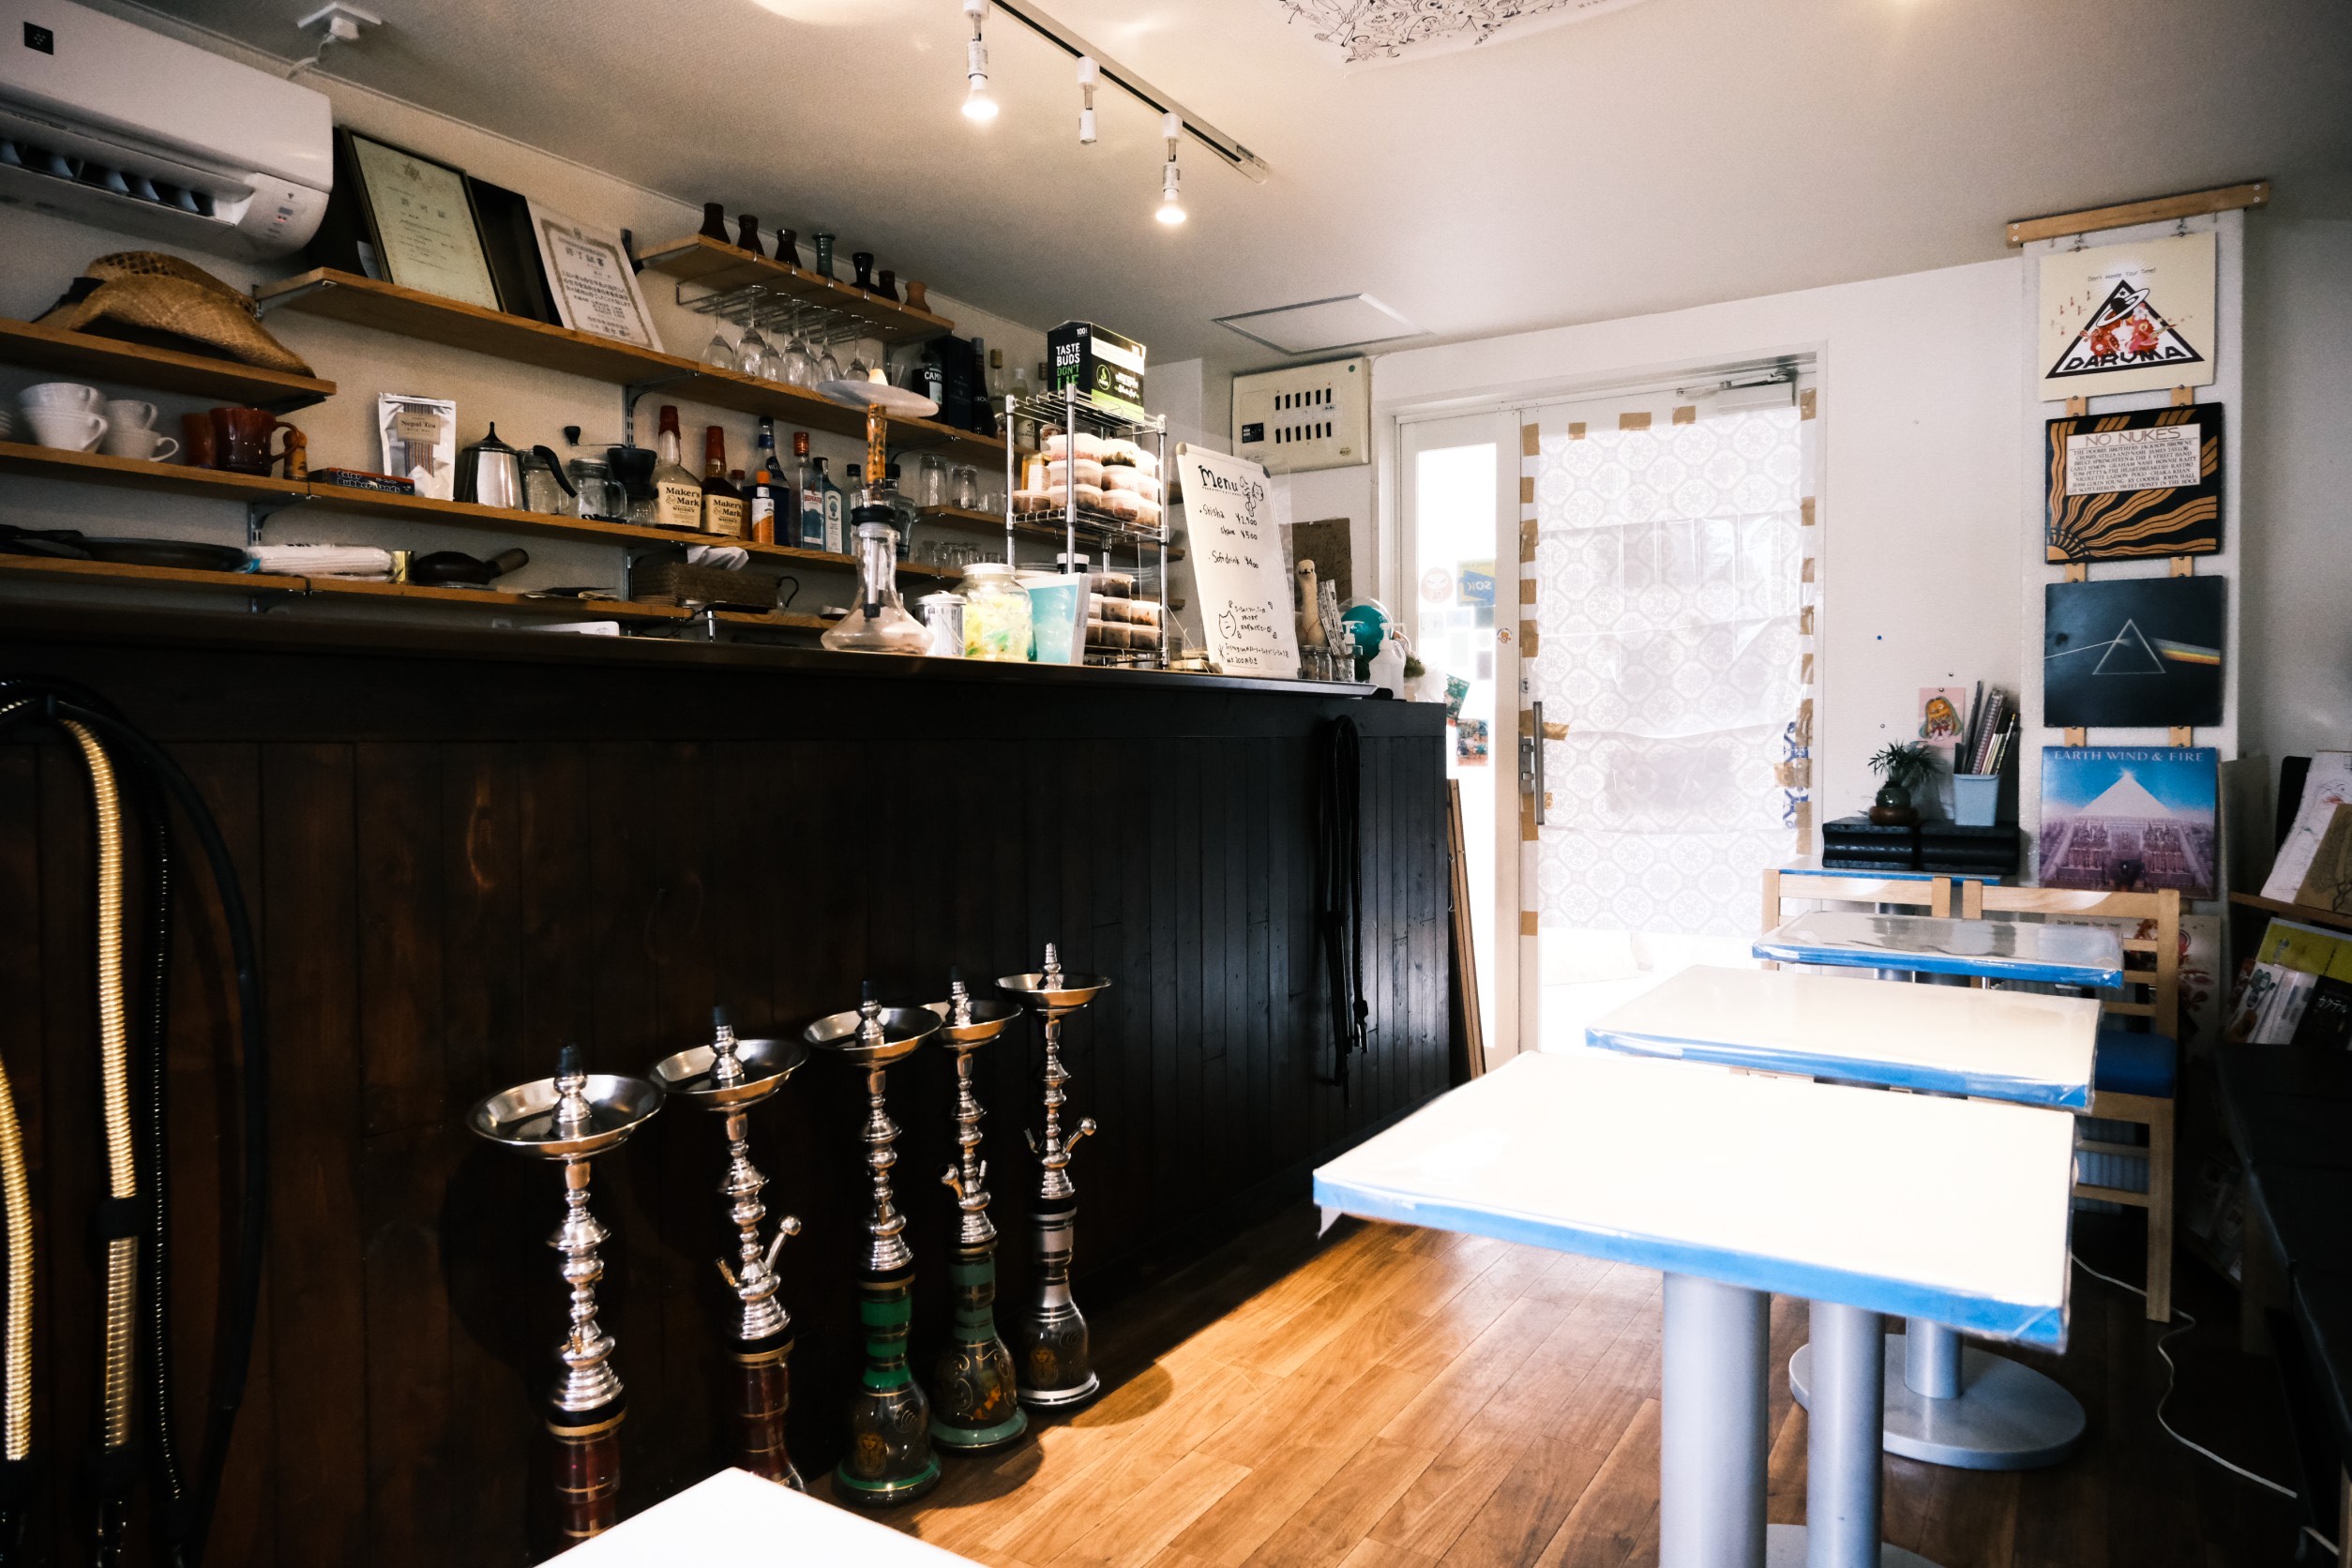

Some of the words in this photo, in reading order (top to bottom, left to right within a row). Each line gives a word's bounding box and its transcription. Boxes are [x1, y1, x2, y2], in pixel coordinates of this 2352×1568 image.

[1056, 342, 1080, 355] TASTE
[1057, 353, 1080, 367] BUDS
[2063, 346, 2187, 370] DARUMA
[1057, 364, 1079, 376] DON'T
[2086, 434, 2111, 446] NO
[2119, 428, 2180, 443] NUKES
[338, 470, 362, 479] Color
[1199, 465, 1238, 491] Menu
[338, 478, 372, 489] Rubber
[665, 487, 700, 497] Maker's
[677, 496, 700, 506] Mark
[713, 498, 743, 509] Maker's
[722, 508, 741, 517] Mark
[1203, 504, 1225, 519] Shisha
[1221, 525, 1235, 535] share
[1241, 530, 1258, 540] ¥500
[1244, 555, 1259, 568] ¥400
[2055, 751, 2101, 760] EARTH
[2106, 751, 2148, 761] WIND
[2151, 752, 2164, 761] &
[2169, 752, 2204, 761] FIRE
[2318, 995, 2348, 1013] カクテル
